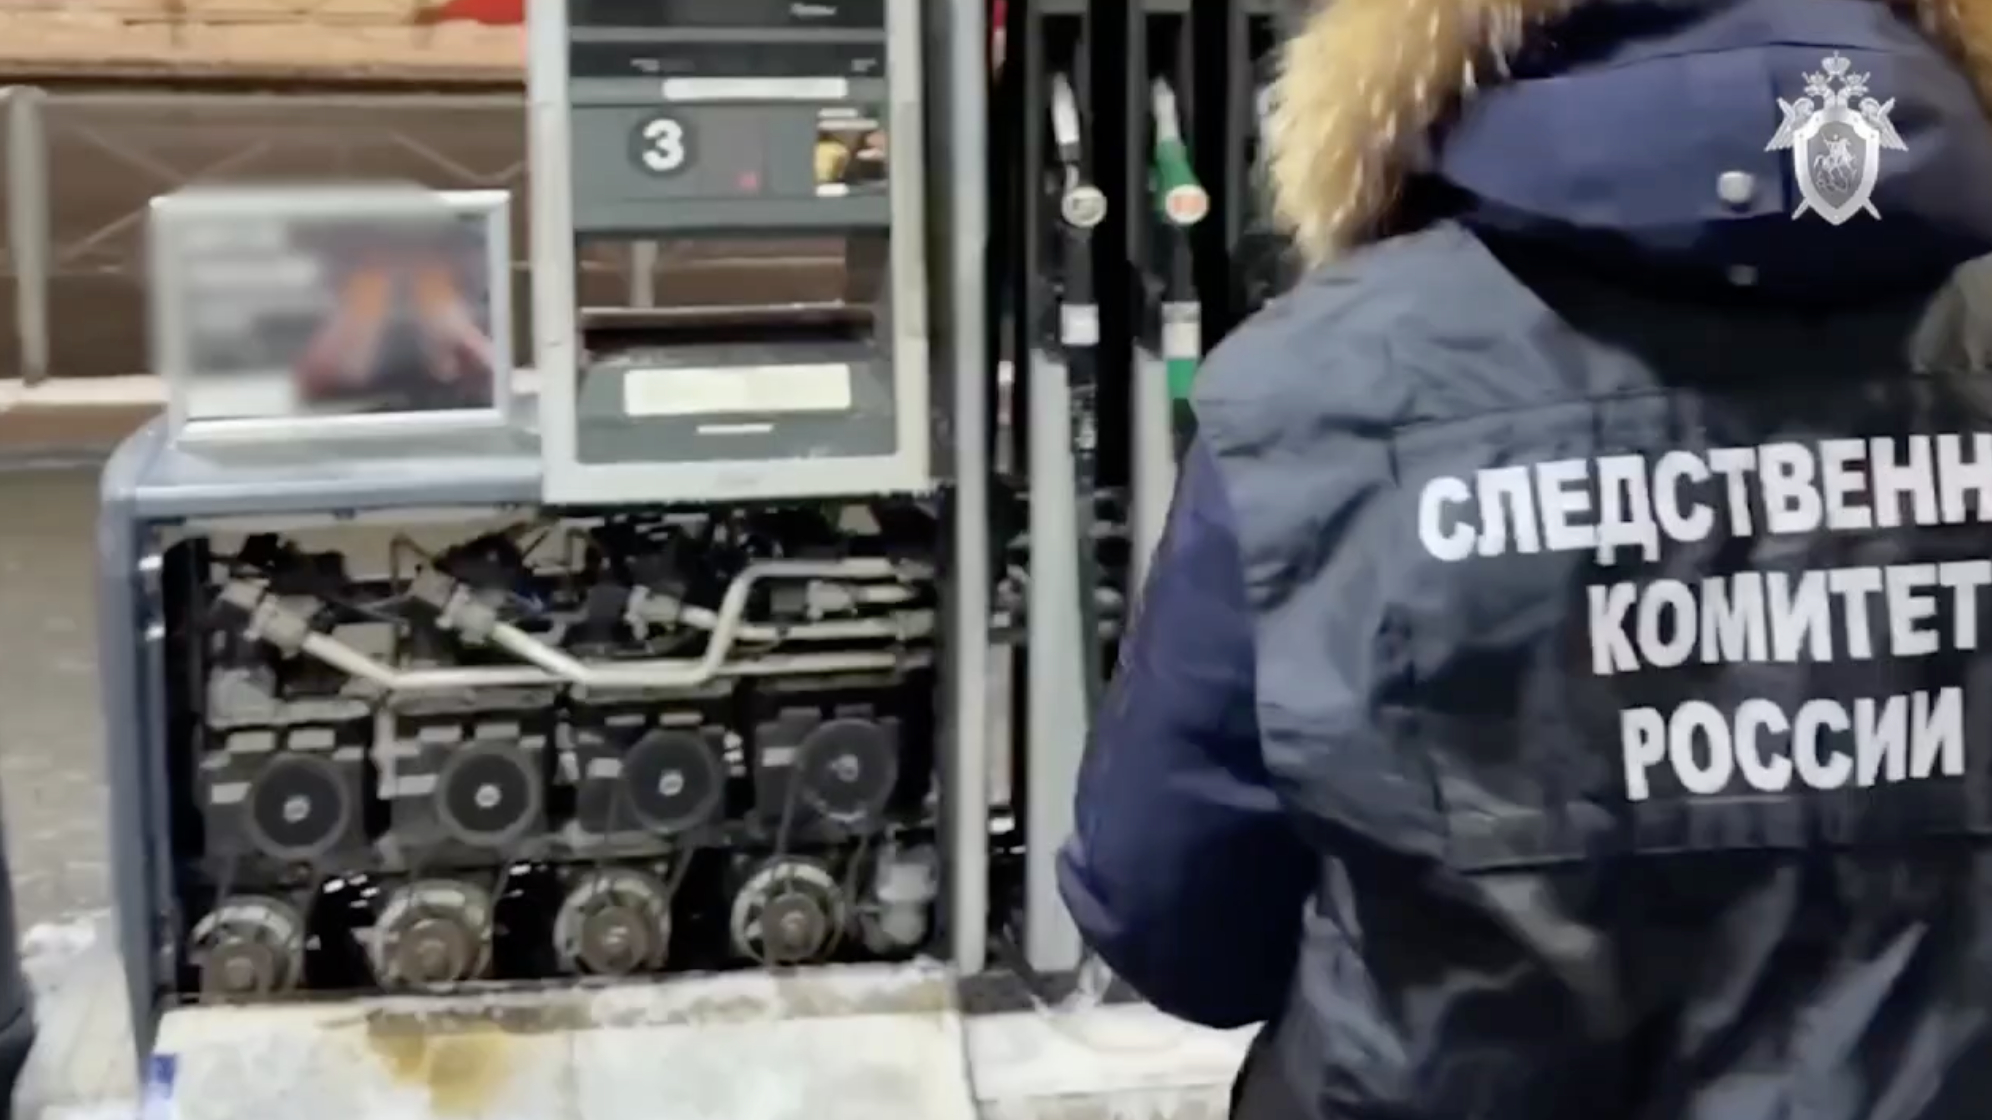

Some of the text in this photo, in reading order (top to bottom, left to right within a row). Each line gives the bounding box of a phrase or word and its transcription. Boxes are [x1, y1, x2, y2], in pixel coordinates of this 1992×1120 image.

[642, 118, 685, 171] 3
[1418, 433, 1992, 564] СЛЕДСТВЕНН
[1588, 561, 1992, 675] КОМИТЕТ
[1620, 687, 1965, 800] РОССИИ
